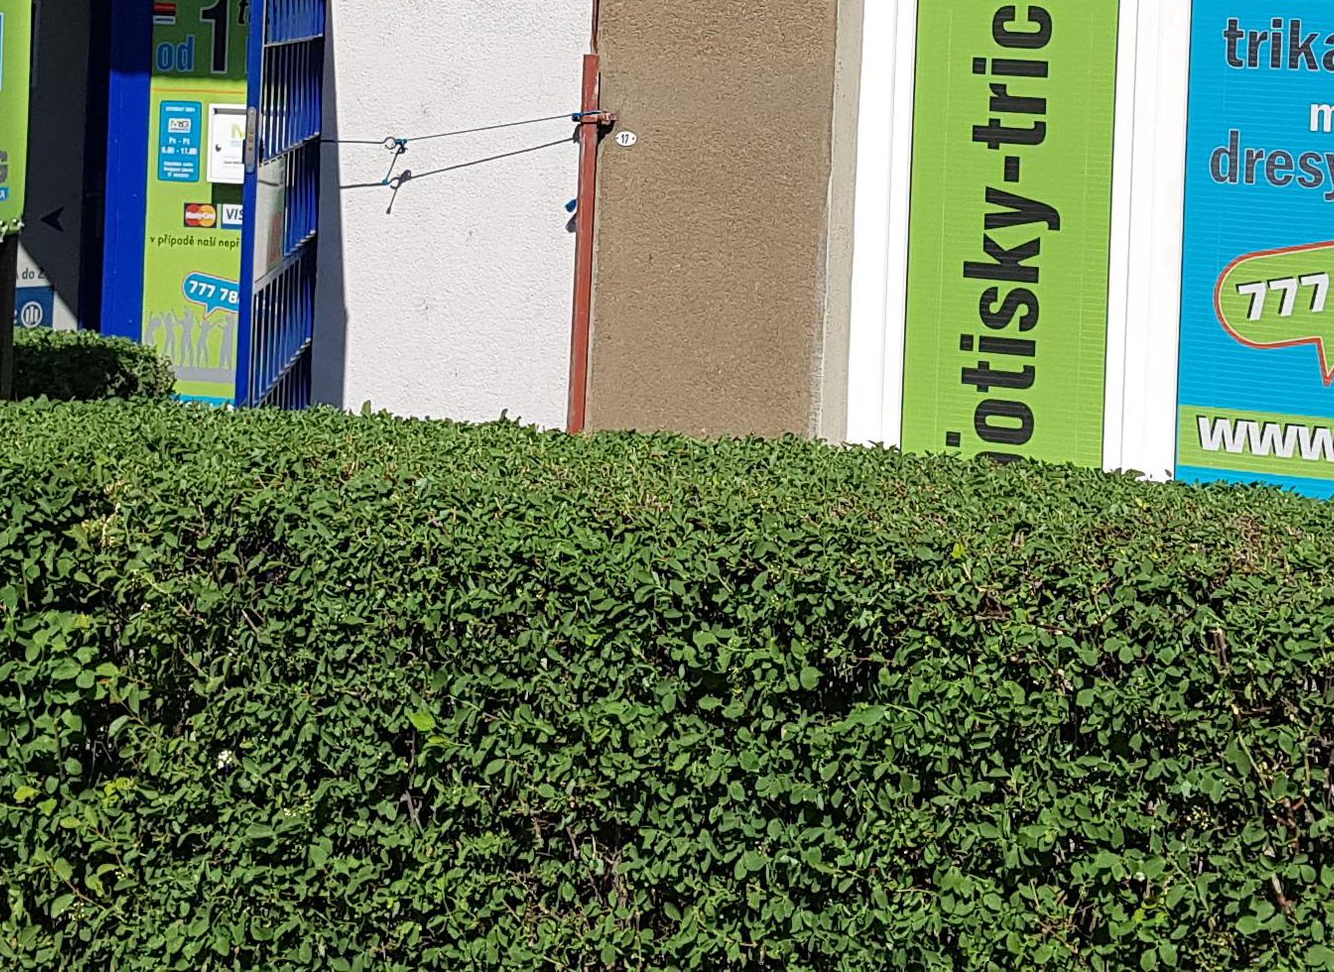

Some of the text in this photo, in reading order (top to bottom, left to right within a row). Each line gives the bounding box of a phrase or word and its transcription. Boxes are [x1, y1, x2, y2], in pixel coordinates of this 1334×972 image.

[156, 35, 195, 73] od
[157, 234, 194, 247] případě
[22, 268, 35, 279] do
[189, 280, 240, 303] 777 78
[1237, 270, 1334, 323] 777
